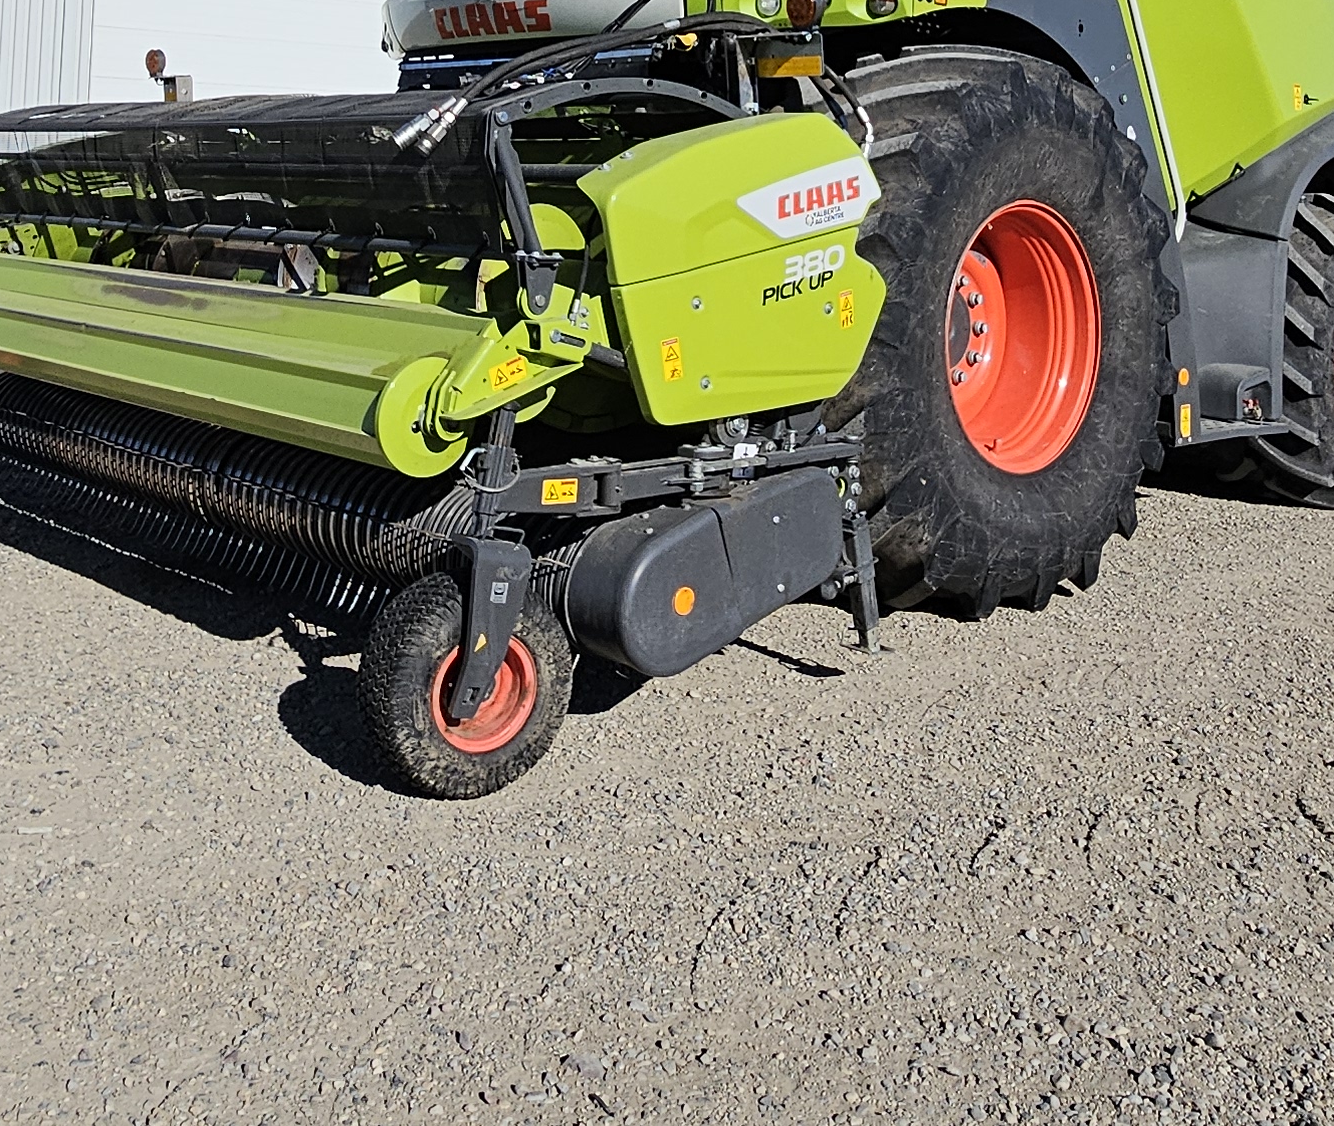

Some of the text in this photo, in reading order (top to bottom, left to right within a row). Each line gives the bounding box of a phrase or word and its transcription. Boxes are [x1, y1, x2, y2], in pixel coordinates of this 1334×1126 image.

[434, 0, 552, 40] CLAAS
[778, 175, 861, 220] CLAAS
[816, 205, 842, 217] ALBERTA
[823, 211, 844, 223] CENTRE
[783, 244, 845, 285] 380
[762, 270, 834, 306] PICK UP
